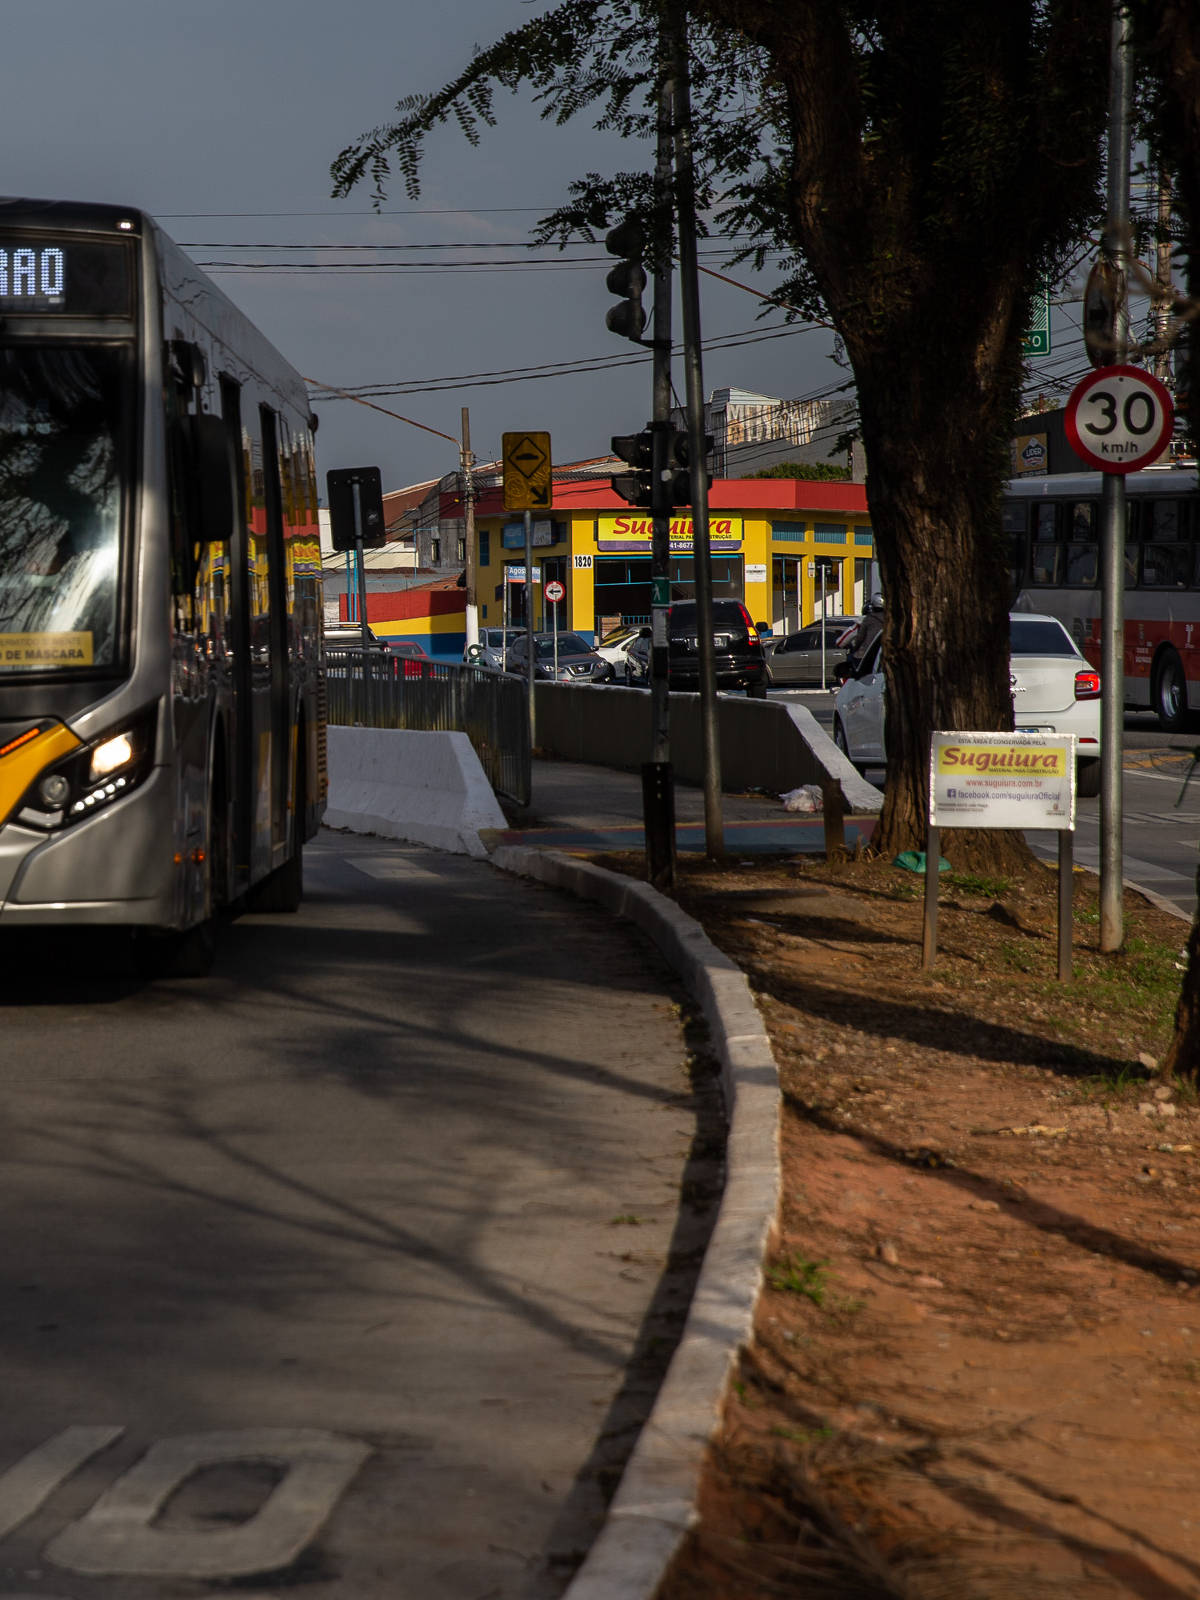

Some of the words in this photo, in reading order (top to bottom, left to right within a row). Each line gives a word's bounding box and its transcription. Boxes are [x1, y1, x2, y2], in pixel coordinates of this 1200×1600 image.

[1084, 391, 1155, 435] 30
[1101, 441, 1138, 453] km/h
[574, 555, 592, 567] 1820
[5, 650, 22, 660] DE
[942, 747, 1058, 772] Suguiura
[966, 779, 1043, 789] www.suguiura.com.br
